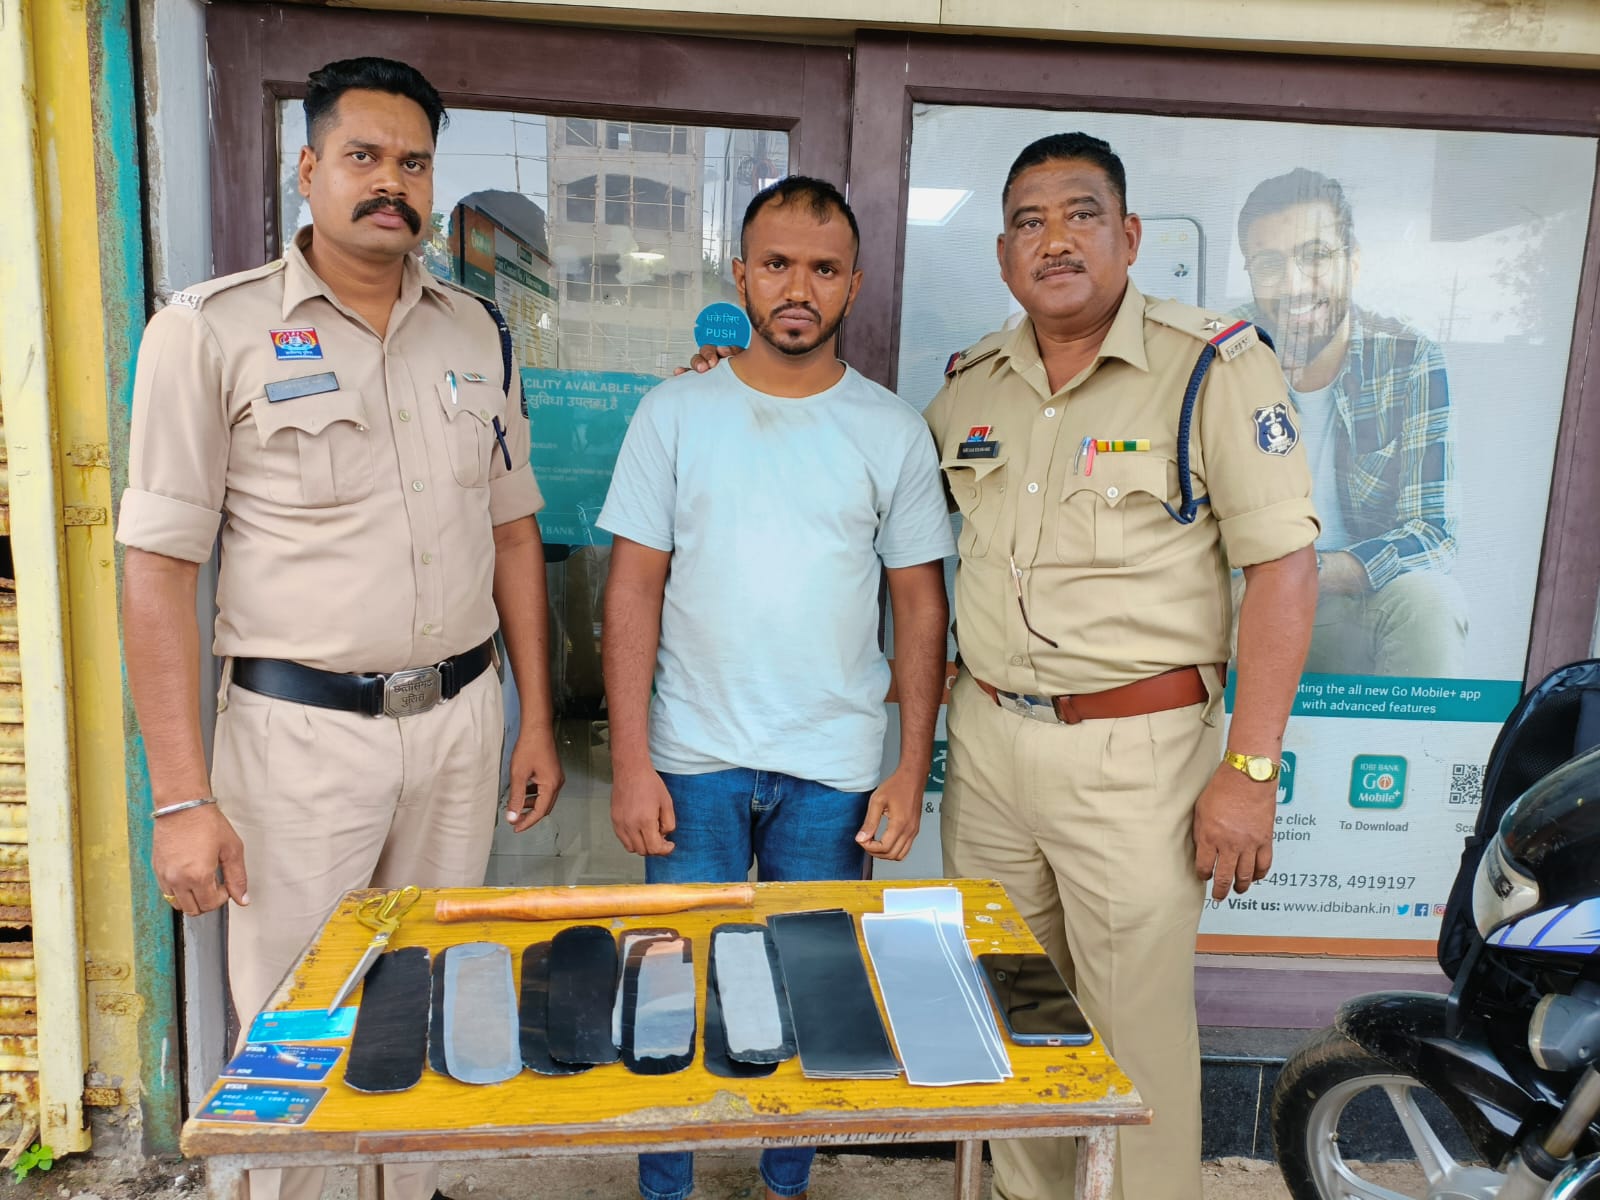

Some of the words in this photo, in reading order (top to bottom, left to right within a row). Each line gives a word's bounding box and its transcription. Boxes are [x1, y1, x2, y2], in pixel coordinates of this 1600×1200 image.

[706, 327, 736, 339] PUSH
[525, 378, 562, 390] CILITY
[565, 380, 631, 394] AVAILABLE
[1327, 683, 1345, 694] the
[1348, 684, 1362, 695] all
[1365, 686, 1389, 696] new
[1391, 686, 1408, 697] Go
[1411, 687, 1456, 699] Mobile+
[1459, 689, 1481, 702] app
[1302, 699, 1327, 710] with
[1330, 700, 1386, 712] advanced
[1389, 702, 1436, 714] features
[1378, 764, 1400, 772] BANK
[1286, 813, 1317, 826] click
[1340, 821, 1352, 830] To
[1355, 821, 1409, 832] Download
[1347, 875, 1416, 890] 4919197
[1228, 898, 1257, 910] Visit
[1261, 901, 1280, 911] us:
[1283, 899, 1391, 915] www.idbibank.in
